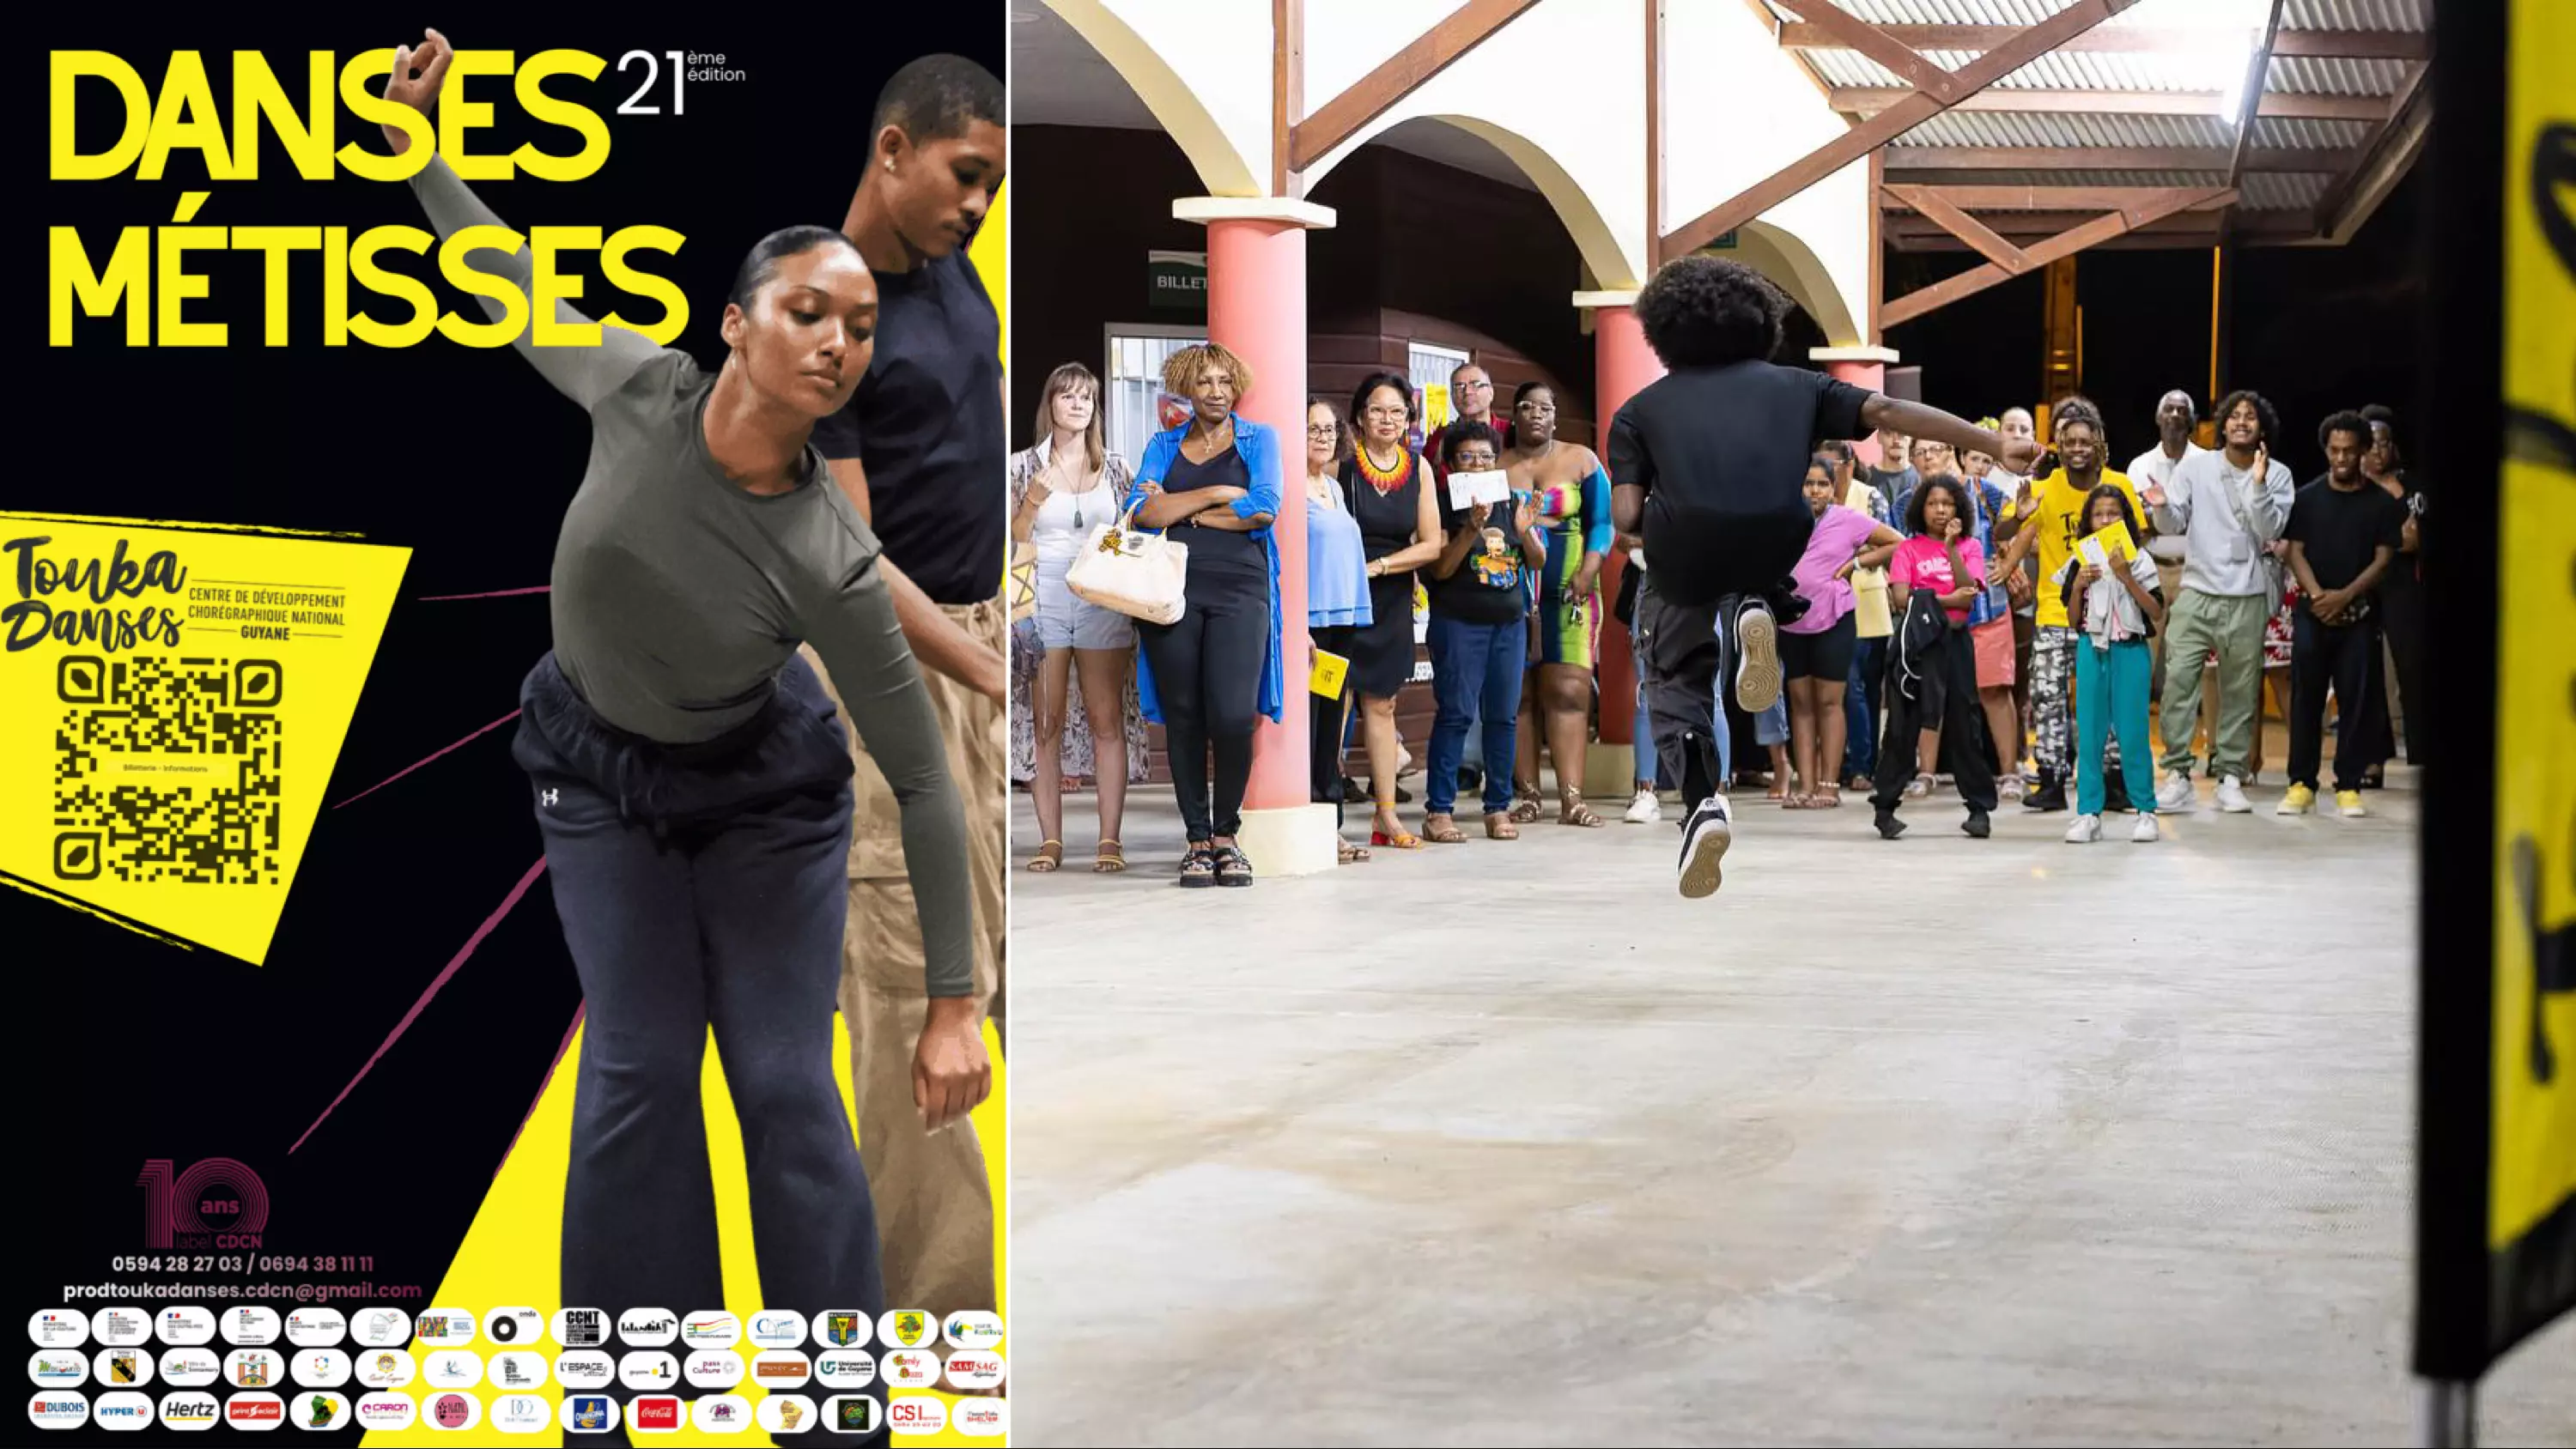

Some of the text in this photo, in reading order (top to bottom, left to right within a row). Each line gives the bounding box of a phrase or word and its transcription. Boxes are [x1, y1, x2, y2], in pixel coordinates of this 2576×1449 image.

[687, 50, 726, 64] ème
[616, 49, 684, 115] 21
[687, 67, 746, 82] édition
[49, 48, 611, 182] DANSES
[49, 191, 690, 349] MÉTISSES
[3, 536, 188, 604] Touka
[189, 587, 345, 609] CENTRE DE DÉVELOPPEMENT
[188, 604, 345, 626] CHORÉGRAPHIQUE NATIONAL
[1, 599, 185, 654] Danses
[240, 625, 290, 641] GUYANE
[135, 1157, 270, 1250] 10
[200, 1199, 240, 1214] ans
[176, 1234, 263, 1249] label CDCN
[112, 1252, 374, 1275] 0594 28 27 03 / 0694 38 11 11
[64, 1282, 422, 1303] prodtoukadanses.cdcn@gmail.com
[565, 1310, 599, 1324] CCNT
[659, 1361, 671, 1378] 1
[46, 1402, 85, 1412] DUBOIS
[100, 1407, 134, 1416] HYPER
[166, 1401, 215, 1416] Hertz
